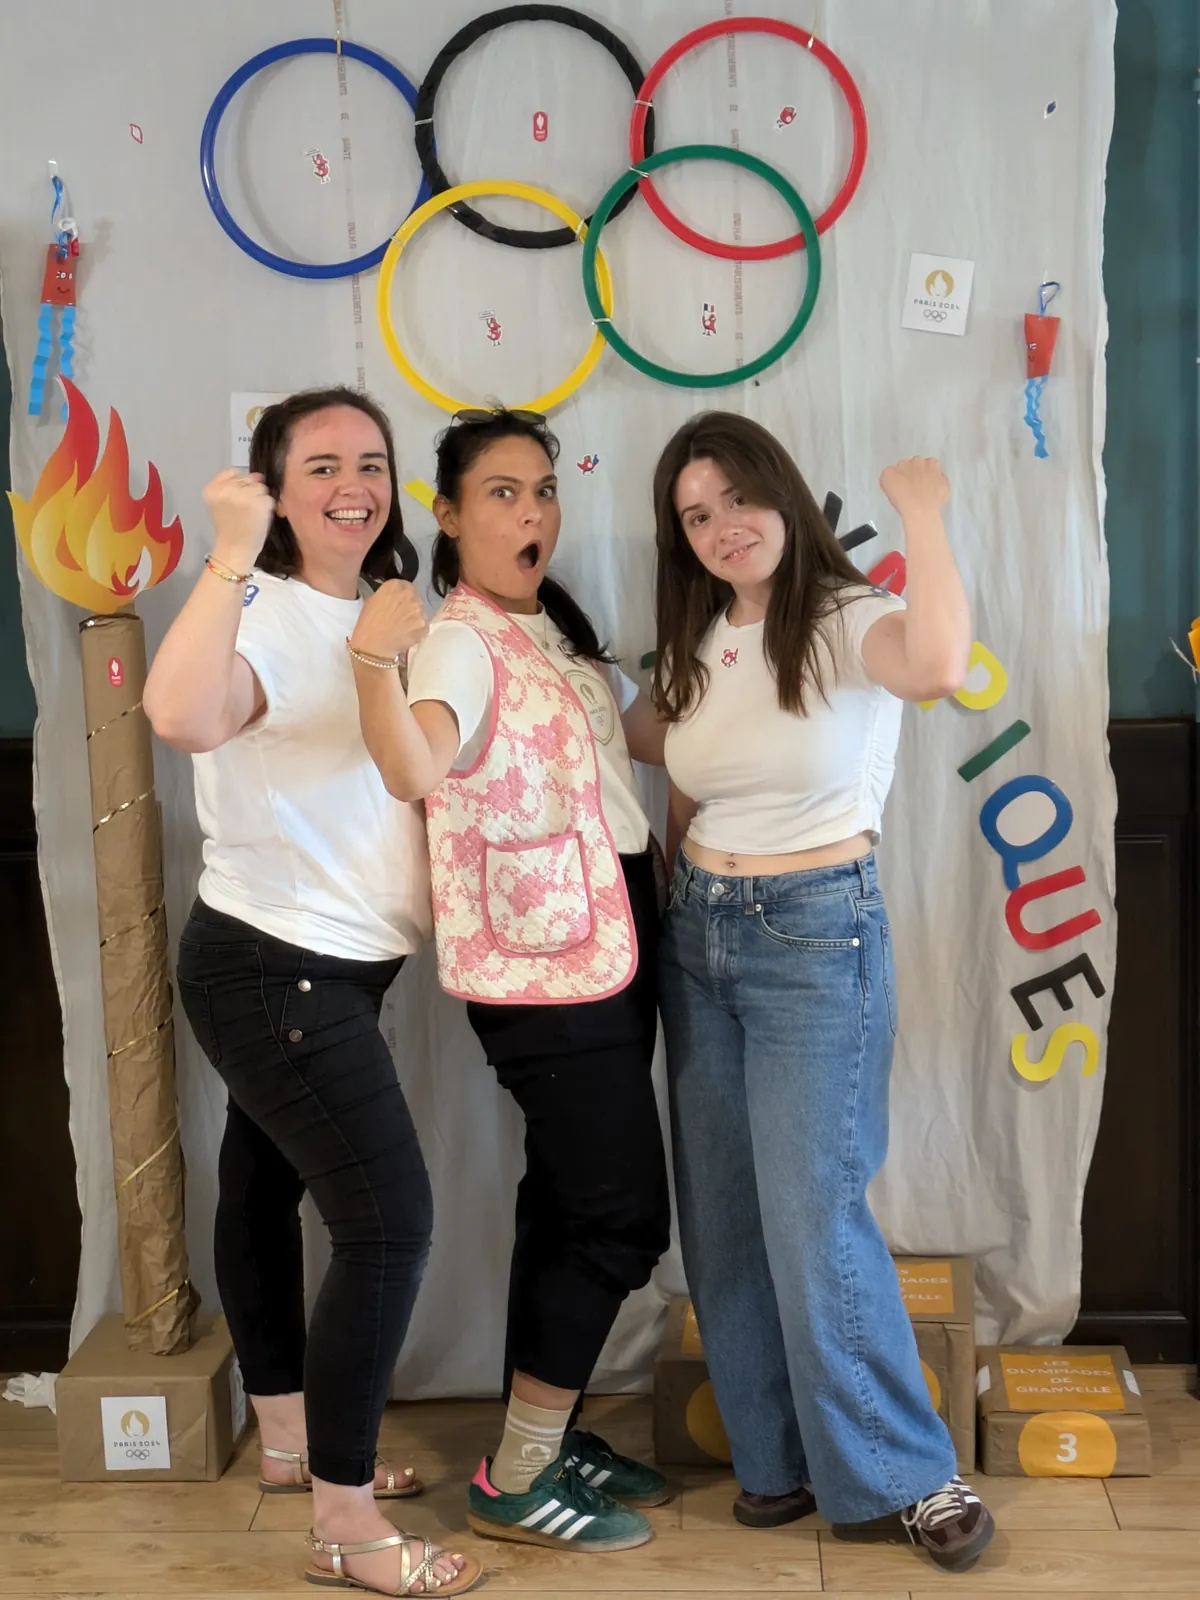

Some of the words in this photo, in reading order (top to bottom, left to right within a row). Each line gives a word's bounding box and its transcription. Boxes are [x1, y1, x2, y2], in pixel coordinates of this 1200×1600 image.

[913, 298, 937, 307] PARIS
[939, 302, 960, 310] 2024
[1006, 1368, 1112, 1376] OLYMPIADES
[1056, 1432, 1078, 1463] 3
